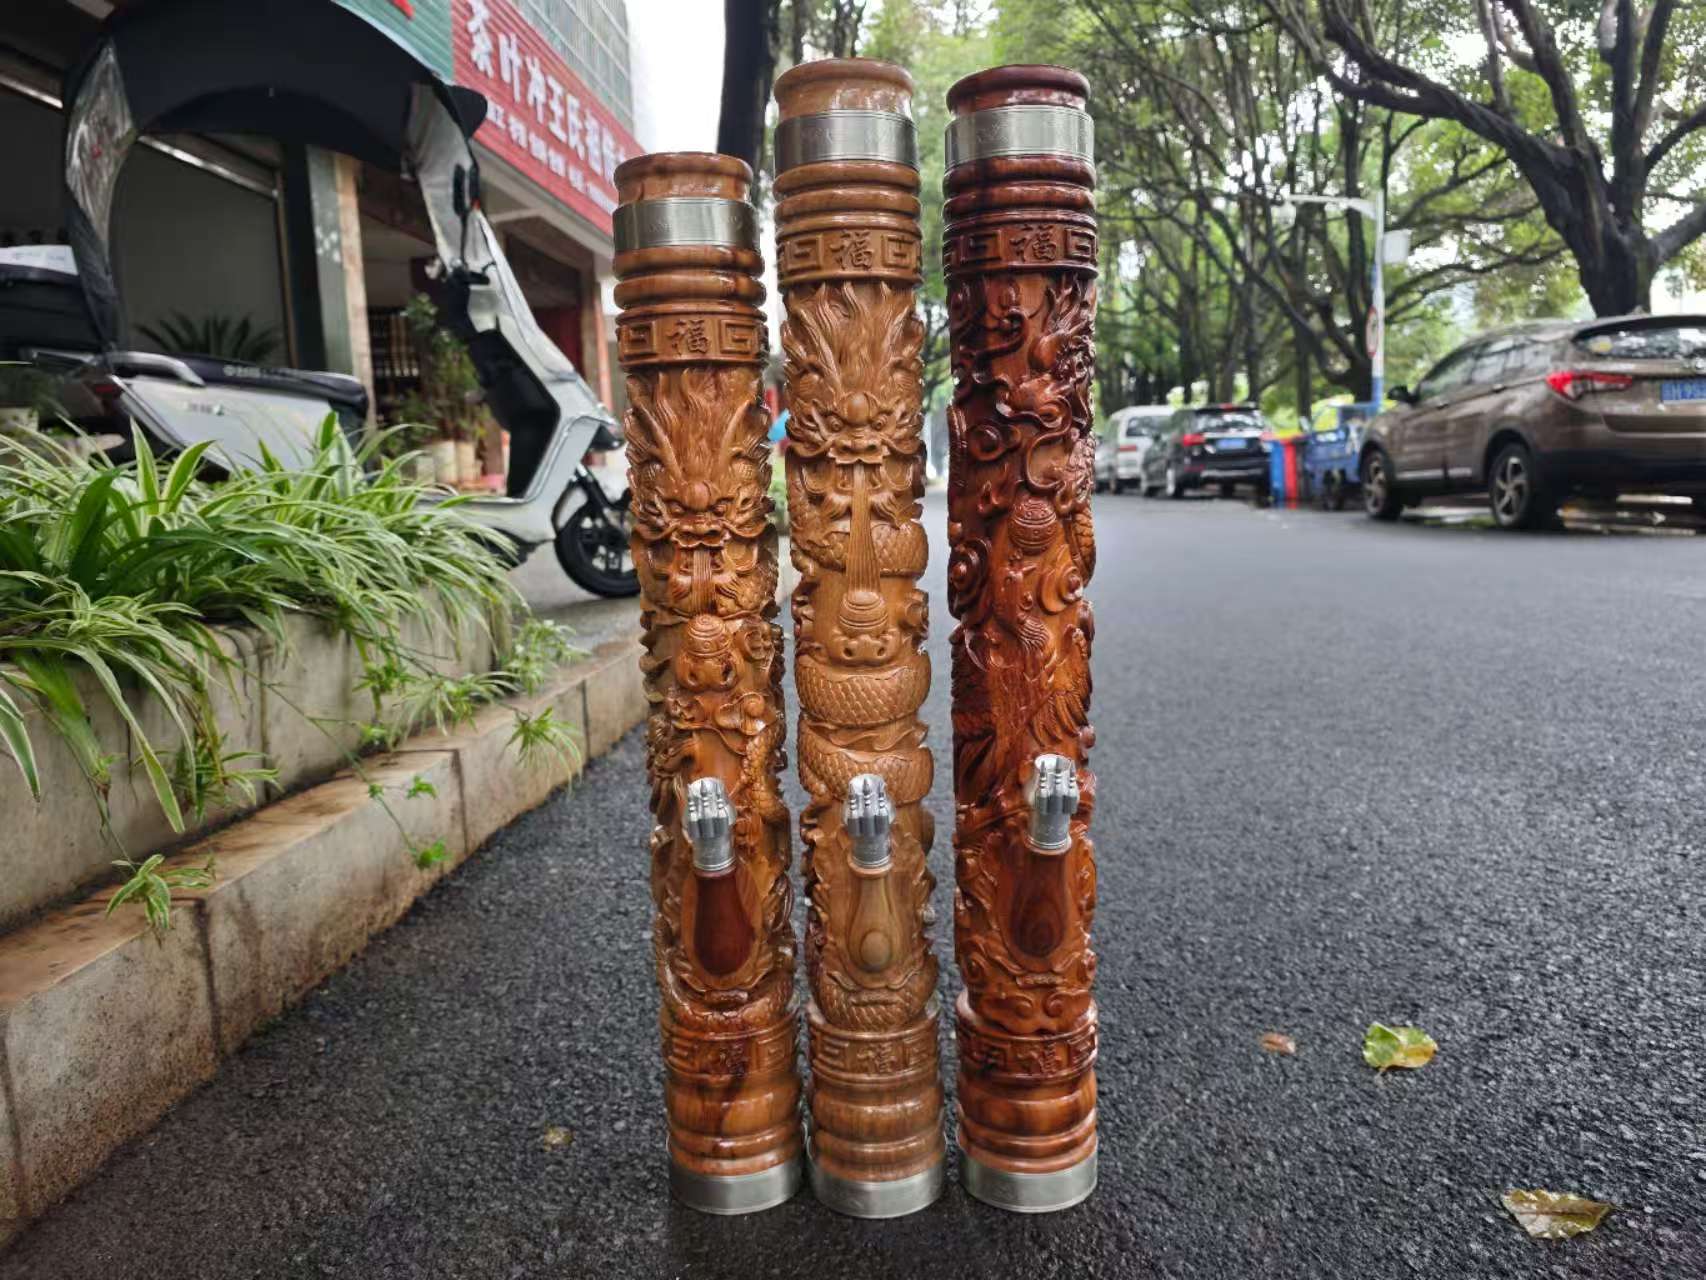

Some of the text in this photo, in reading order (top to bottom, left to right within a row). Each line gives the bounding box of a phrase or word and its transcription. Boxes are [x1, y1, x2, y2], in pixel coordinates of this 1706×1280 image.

[830, 229, 874, 271] 福
[1009, 223, 1057, 263] 福
[666, 318, 709, 356] 福
